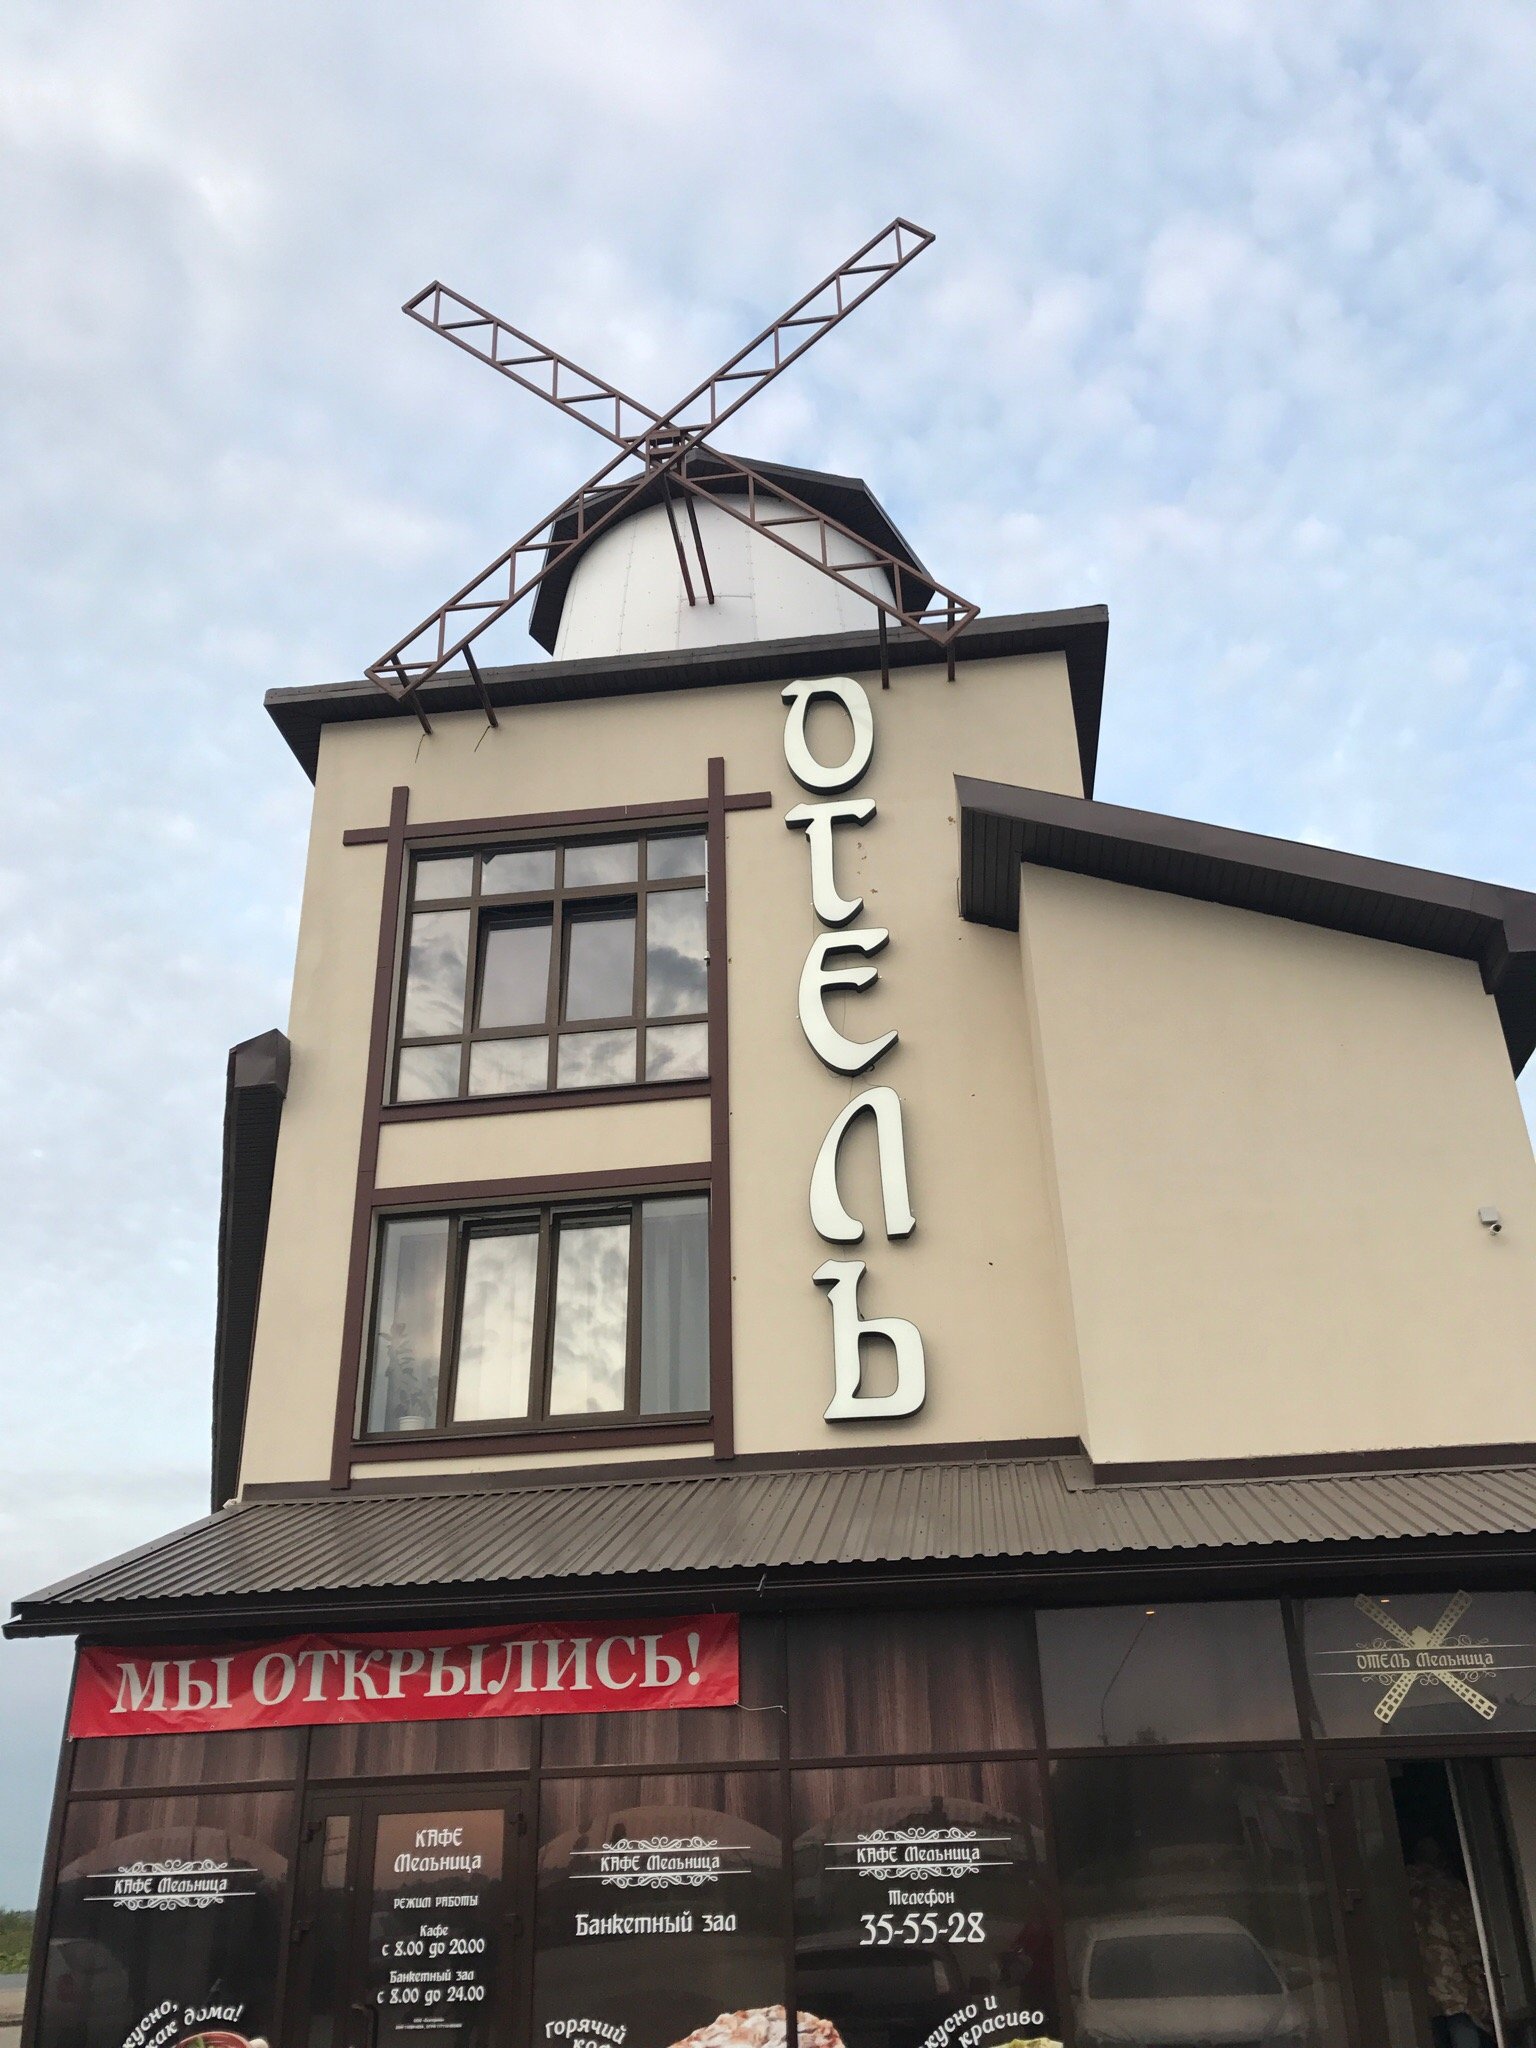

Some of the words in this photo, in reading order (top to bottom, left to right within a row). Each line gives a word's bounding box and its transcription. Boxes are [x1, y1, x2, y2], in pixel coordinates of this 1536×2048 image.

[781, 676, 927, 1424] ОТЕЛЬ
[1356, 1653, 1410, 1669] ОТЕЛЬ
[1416, 1652, 1494, 1668] Мельница
[110, 1655, 235, 1714] МЫ
[251, 1632, 701, 1707] ОТКРЫЛИСЬ!
[415, 1828, 463, 1848] КАФЕ
[393, 1853, 482, 1873] Мельница
[600, 1856, 641, 1872] КАФЕ
[646, 1855, 721, 1871] Мельница
[857, 1846, 898, 1863] КАФЕ
[904, 1845, 980, 1863] Мельница
[114, 1878, 153, 1895] КАФЕ
[157, 1877, 228, 1894] Мельница
[888, 1889, 955, 1907] Телефон
[420, 1924, 449, 1938] Кафе
[575, 1911, 693, 1936] Банкетный
[701, 1914, 737, 1932] зал
[859, 1912, 986, 1945] 35-55-28
[394, 1940, 424, 1957] 8.00
[448, 1938, 485, 1955] 20.00
[389, 1969, 452, 1984] Банкетный
[456, 1970, 475, 1981] зал
[389, 1987, 419, 2004] 8.00
[447, 1985, 485, 2002] 24.00
[121, 2000, 179, 2048] кусно,
[183, 2004, 243, 2026] дома!
[918, 2003, 978, 2048] кусно
[984, 1995, 998, 2011] и
[545, 2018, 627, 2045] горячий
[958, 2010, 1044, 2048] красиво
